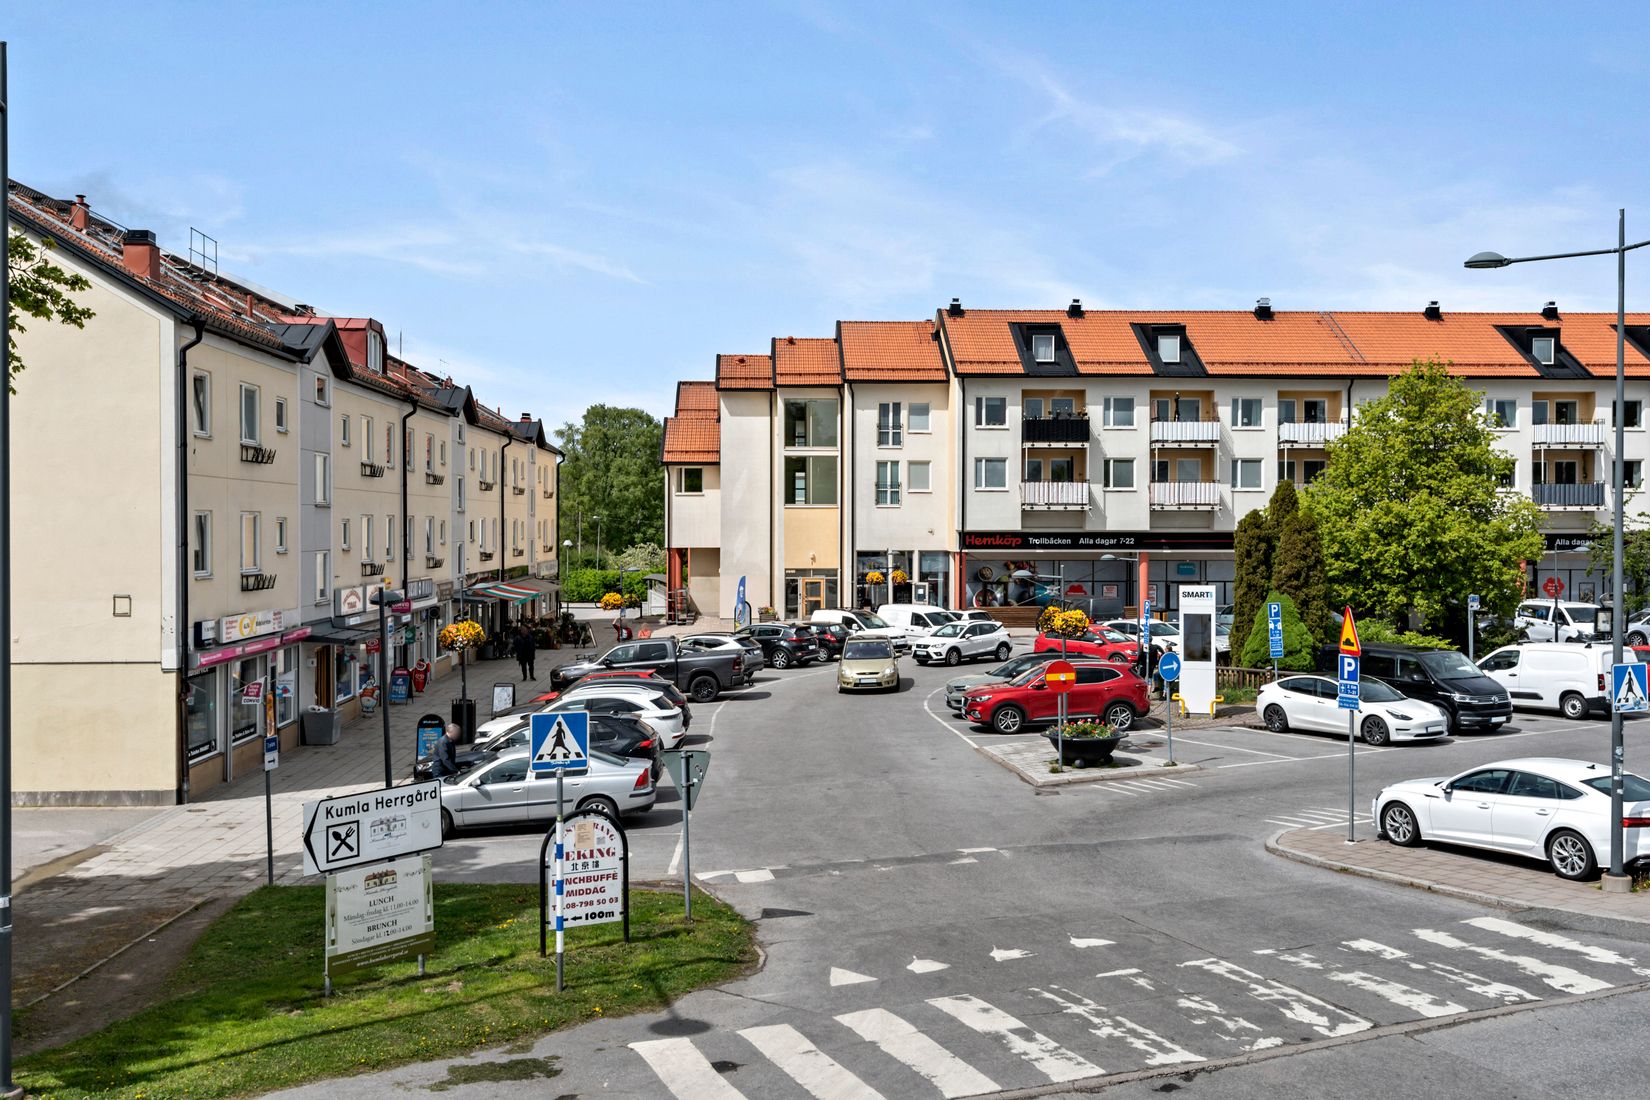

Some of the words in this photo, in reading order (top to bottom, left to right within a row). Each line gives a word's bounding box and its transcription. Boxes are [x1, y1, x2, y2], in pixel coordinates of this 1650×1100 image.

[965, 534, 1021, 547] Hemköp
[1028, 537, 1071, 545] Trollbäcken
[1095, 537, 1117, 545] dagar
[1271, 604, 1278, 617] P
[1343, 657, 1356, 679] P
[325, 801, 370, 820] Kumla
[375, 786, 437, 810] Herrgård
[555, 847, 616, 862] EKING
[551, 871, 618, 887] LNCHBUFFÉ
[565, 886, 606, 898] MIDDAG
[369, 896, 394, 907] LUNCH
[596, 898, 607, 906] 50
[608, 896, 619, 904] 03
[585, 911, 615, 921] 100m
[367, 919, 398, 932] BRUNCH
